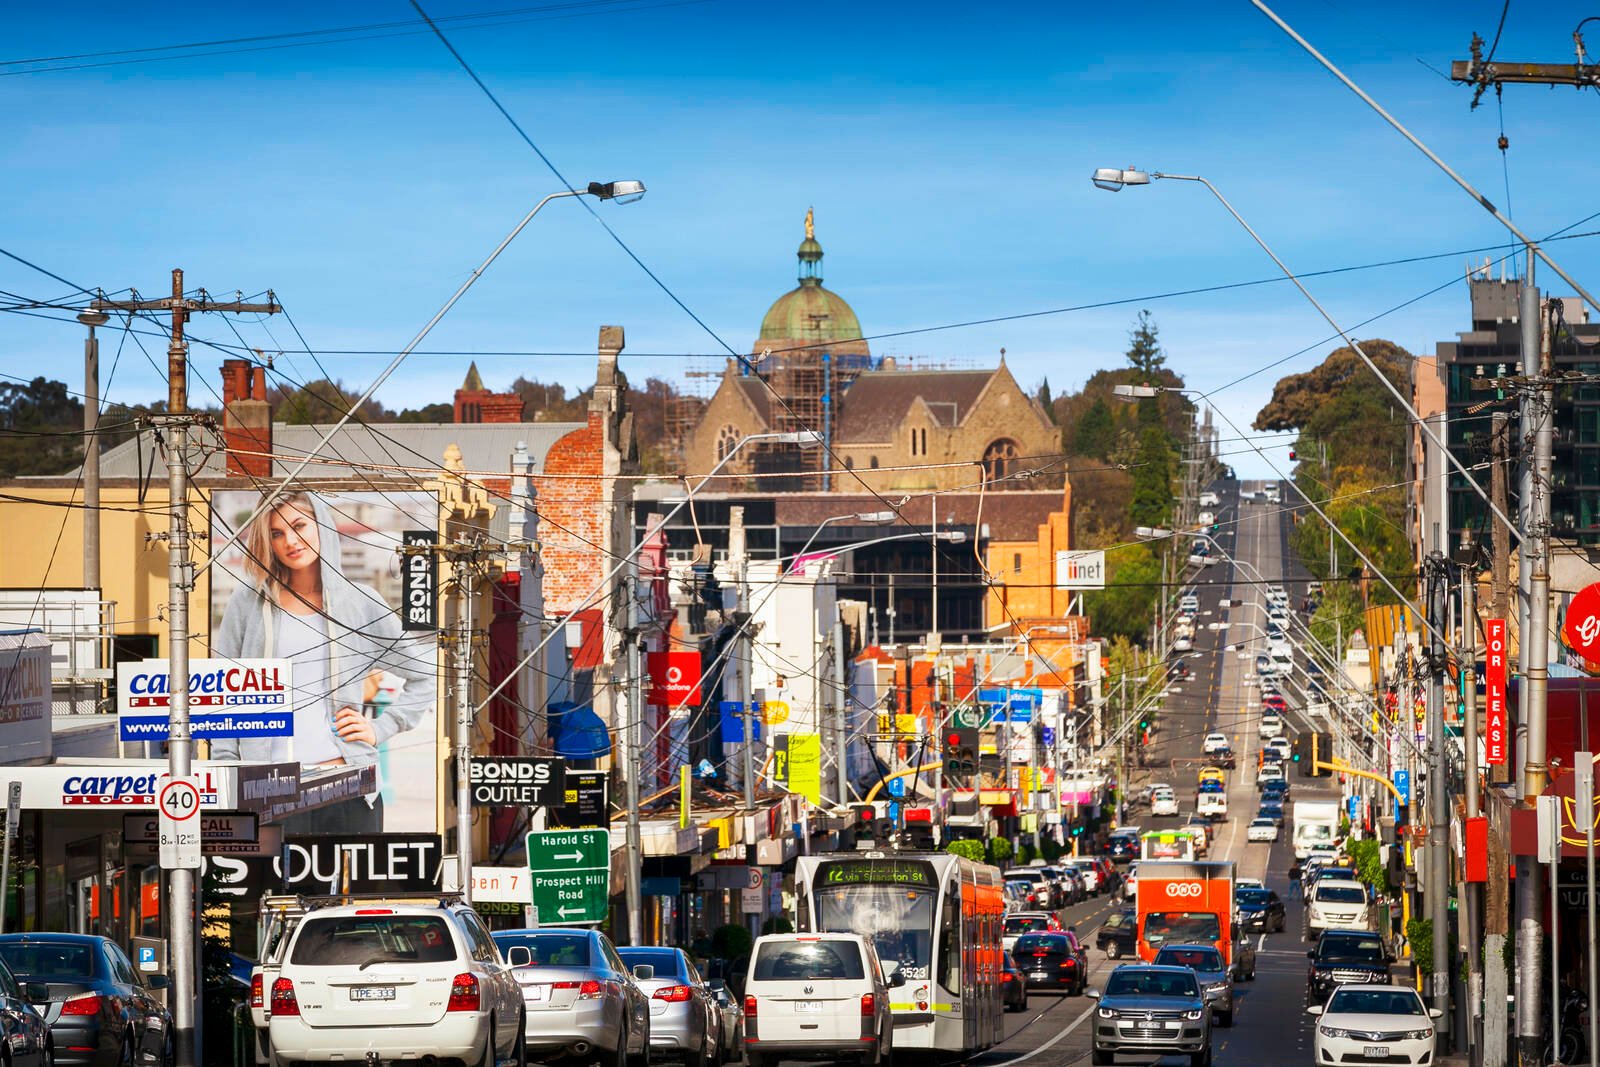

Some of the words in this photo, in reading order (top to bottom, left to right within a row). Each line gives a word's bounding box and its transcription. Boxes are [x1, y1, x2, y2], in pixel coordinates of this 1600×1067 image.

[1068, 560, 1100, 579] iinet
[1491, 625, 1502, 666] FOR
[129, 667, 285, 694] capetCALL
[131, 695, 221, 707] FLOR
[227, 693, 284, 704] CENTRE
[125, 718, 286, 735] www.petcall.com.au
[1491, 685, 1502, 757] LEASE
[470, 762, 550, 779] BONDS
[65, 796, 153, 804] FLOOR
[166, 791, 193, 809] 40
[475, 786, 542, 802] OUTLET
[542, 836, 577, 846] Harold
[583, 835, 595, 844] St
[272, 842, 435, 883] OUTLET
[510, 875, 519, 890] 7
[536, 875, 581, 889] Prospect
[586, 876, 605, 885] Hill
[845, 872, 860, 881] via
[912, 872, 923, 881] St
[558, 890, 583, 900] Road
